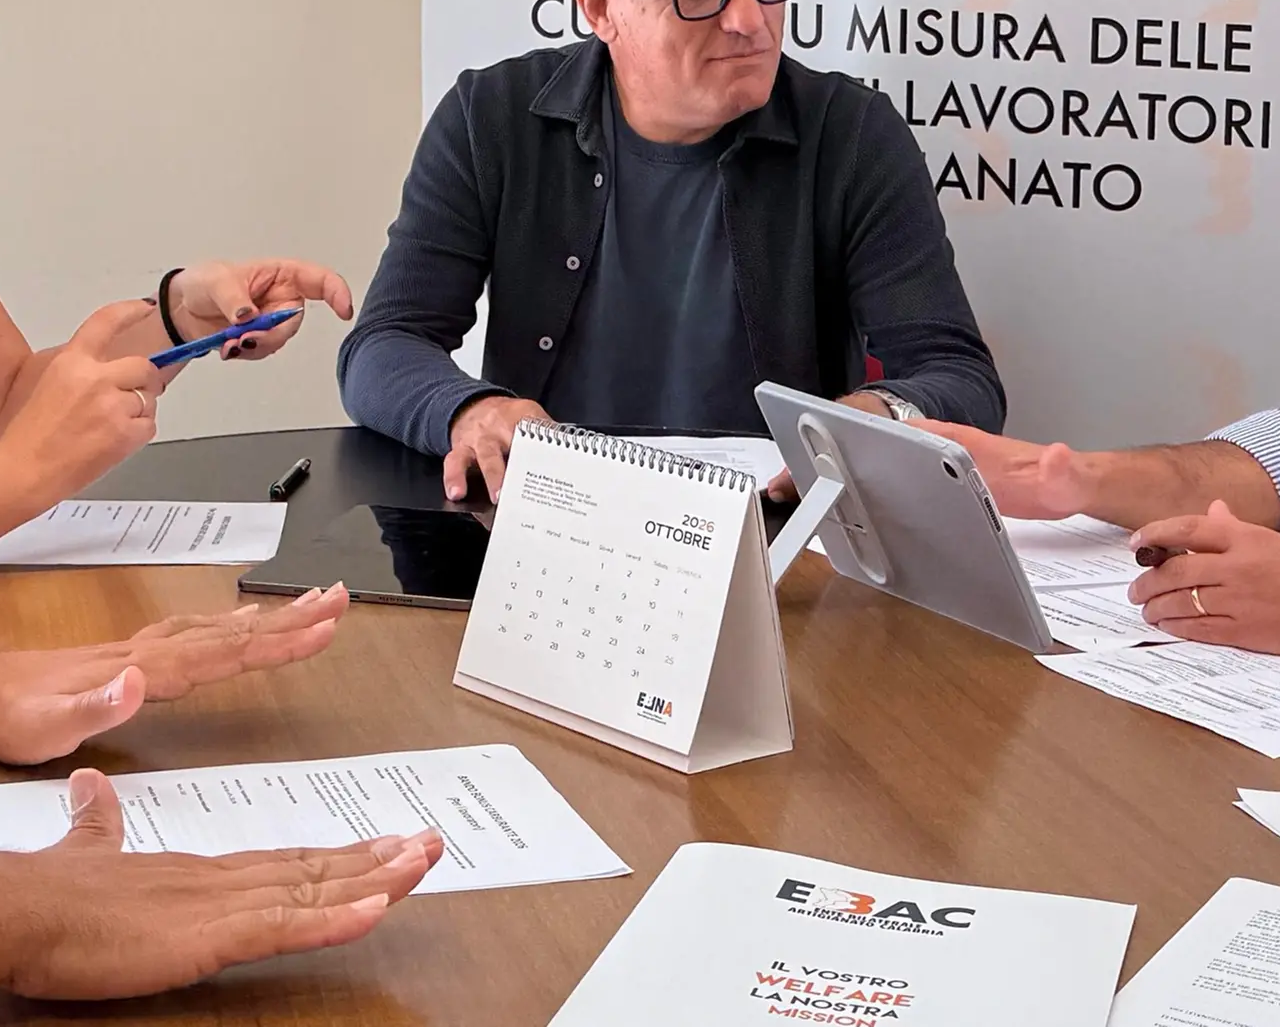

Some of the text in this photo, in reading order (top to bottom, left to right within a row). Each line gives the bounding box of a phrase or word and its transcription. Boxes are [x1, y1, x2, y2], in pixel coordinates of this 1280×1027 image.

[789, 2, 1254, 74] U MISURA DELLE
[905, 79, 1272, 150] LAVORATORI
[644, 520, 712, 551] OTTOBRE
[681, 514, 715, 533] 2026
[581, 629, 591, 638] 22
[631, 669, 640, 678] 31
[788, 906, 944, 936] ARTIGIANATO CALABRIA
[813, 907, 922, 928] ENTE BILATERALE
[756, 971, 915, 1007] WELFARE
[771, 960, 909, 989] IL VOSTRO
[750, 987, 899, 1019] LA NOSTRA
[768, 1005, 876, 1027] MISSION
